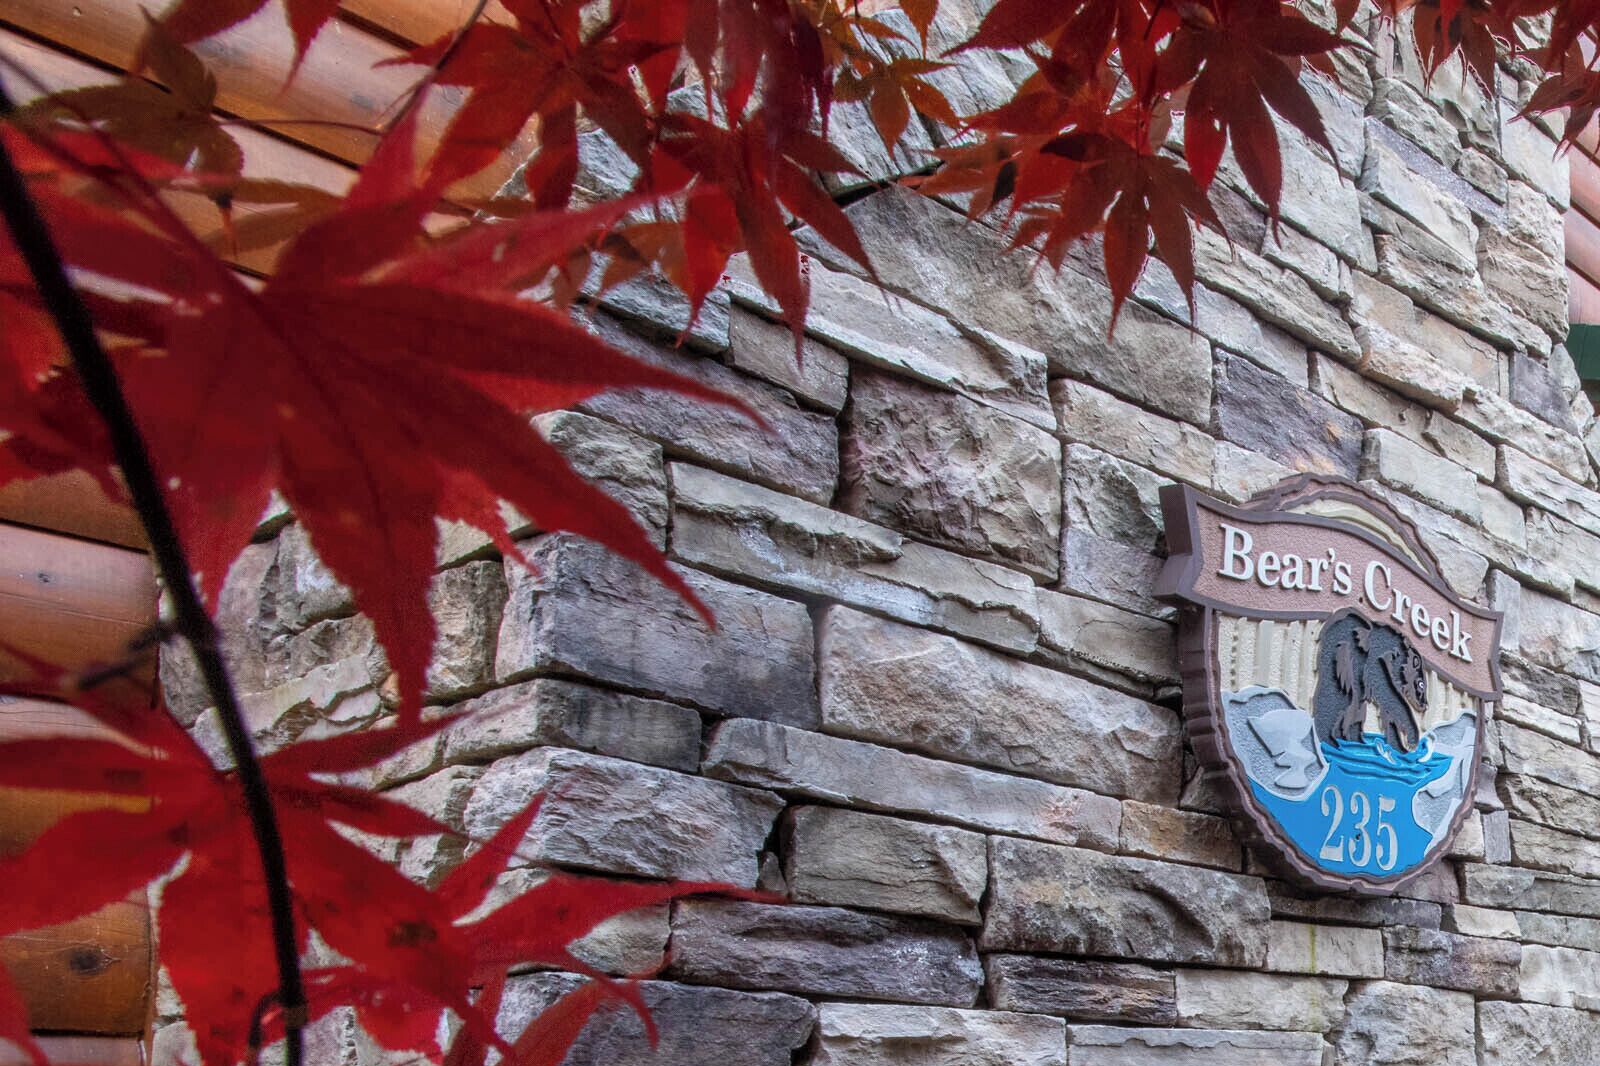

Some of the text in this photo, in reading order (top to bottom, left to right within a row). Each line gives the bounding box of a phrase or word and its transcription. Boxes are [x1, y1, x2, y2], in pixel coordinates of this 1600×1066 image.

[1218, 524, 1474, 664] Bear's Creek
[1320, 785, 1397, 872] 235
